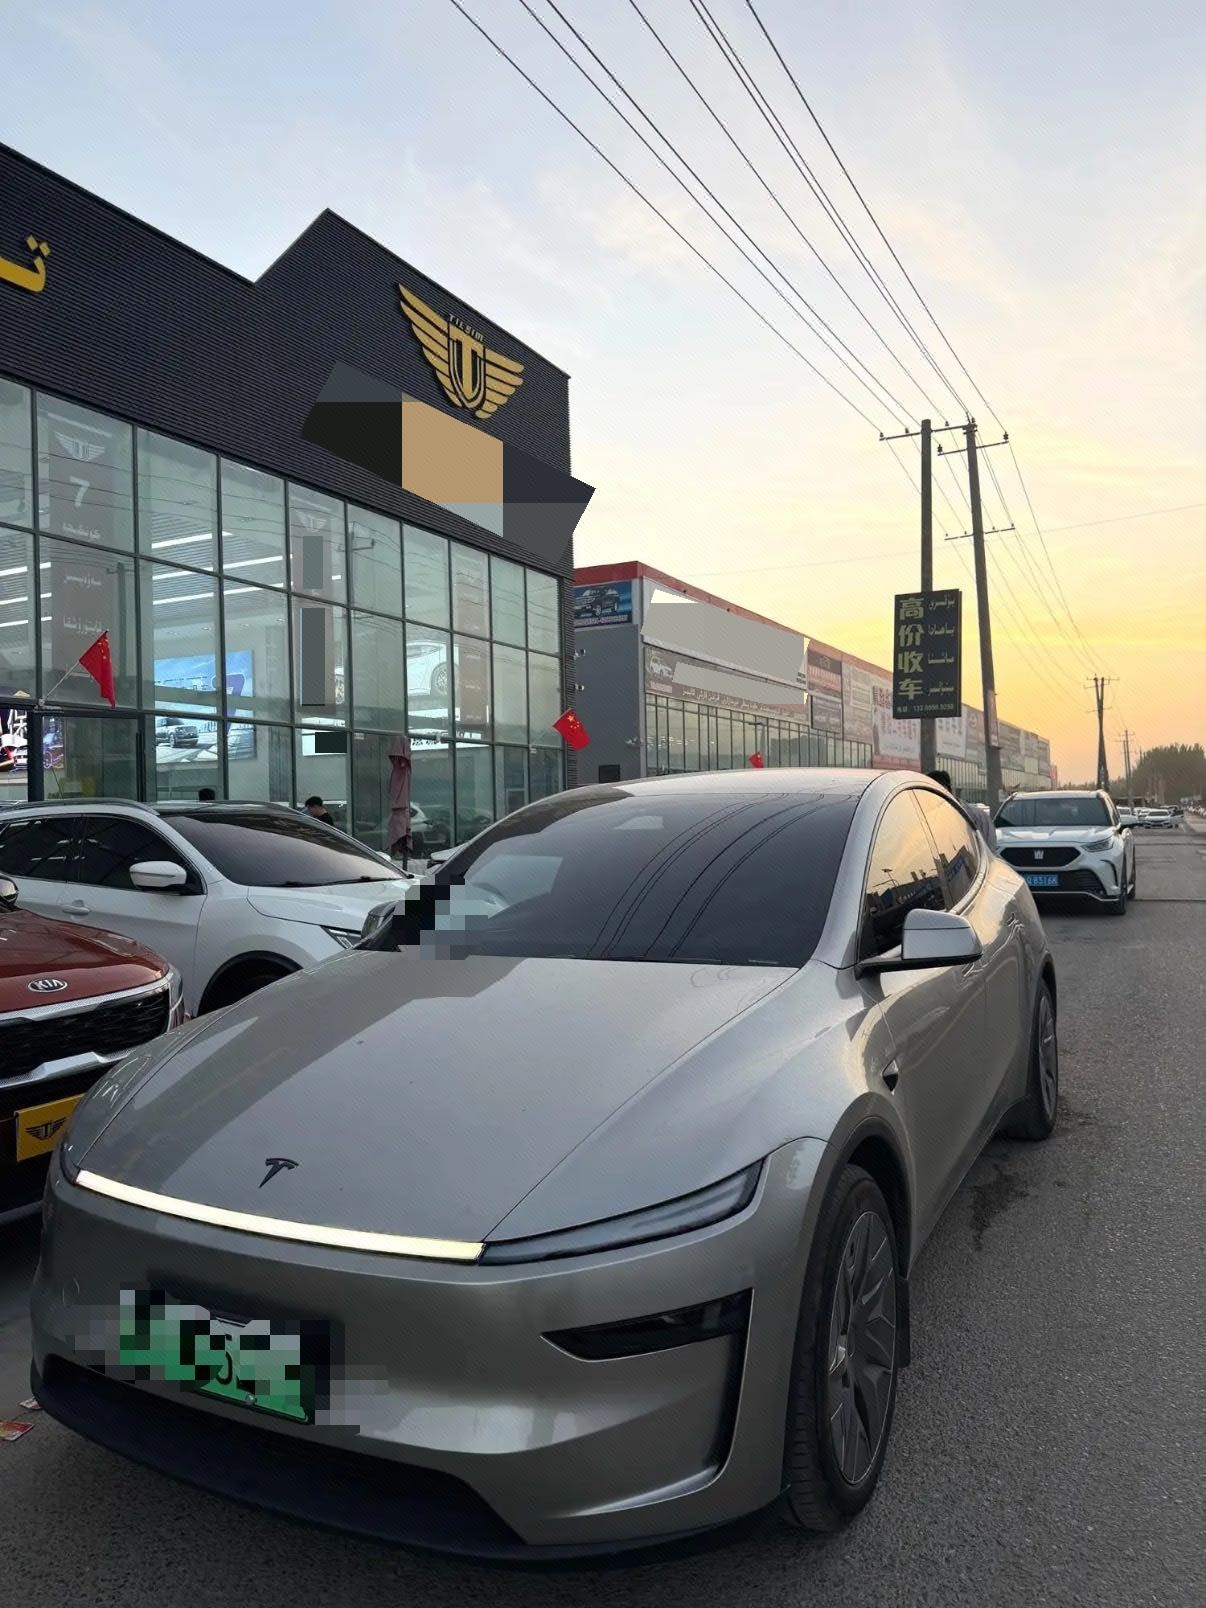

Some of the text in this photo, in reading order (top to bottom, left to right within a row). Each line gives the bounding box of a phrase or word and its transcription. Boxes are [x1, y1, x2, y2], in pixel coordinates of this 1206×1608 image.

[898, 597, 924, 701] 高价收车
[36, 978, 63, 990] KIA
